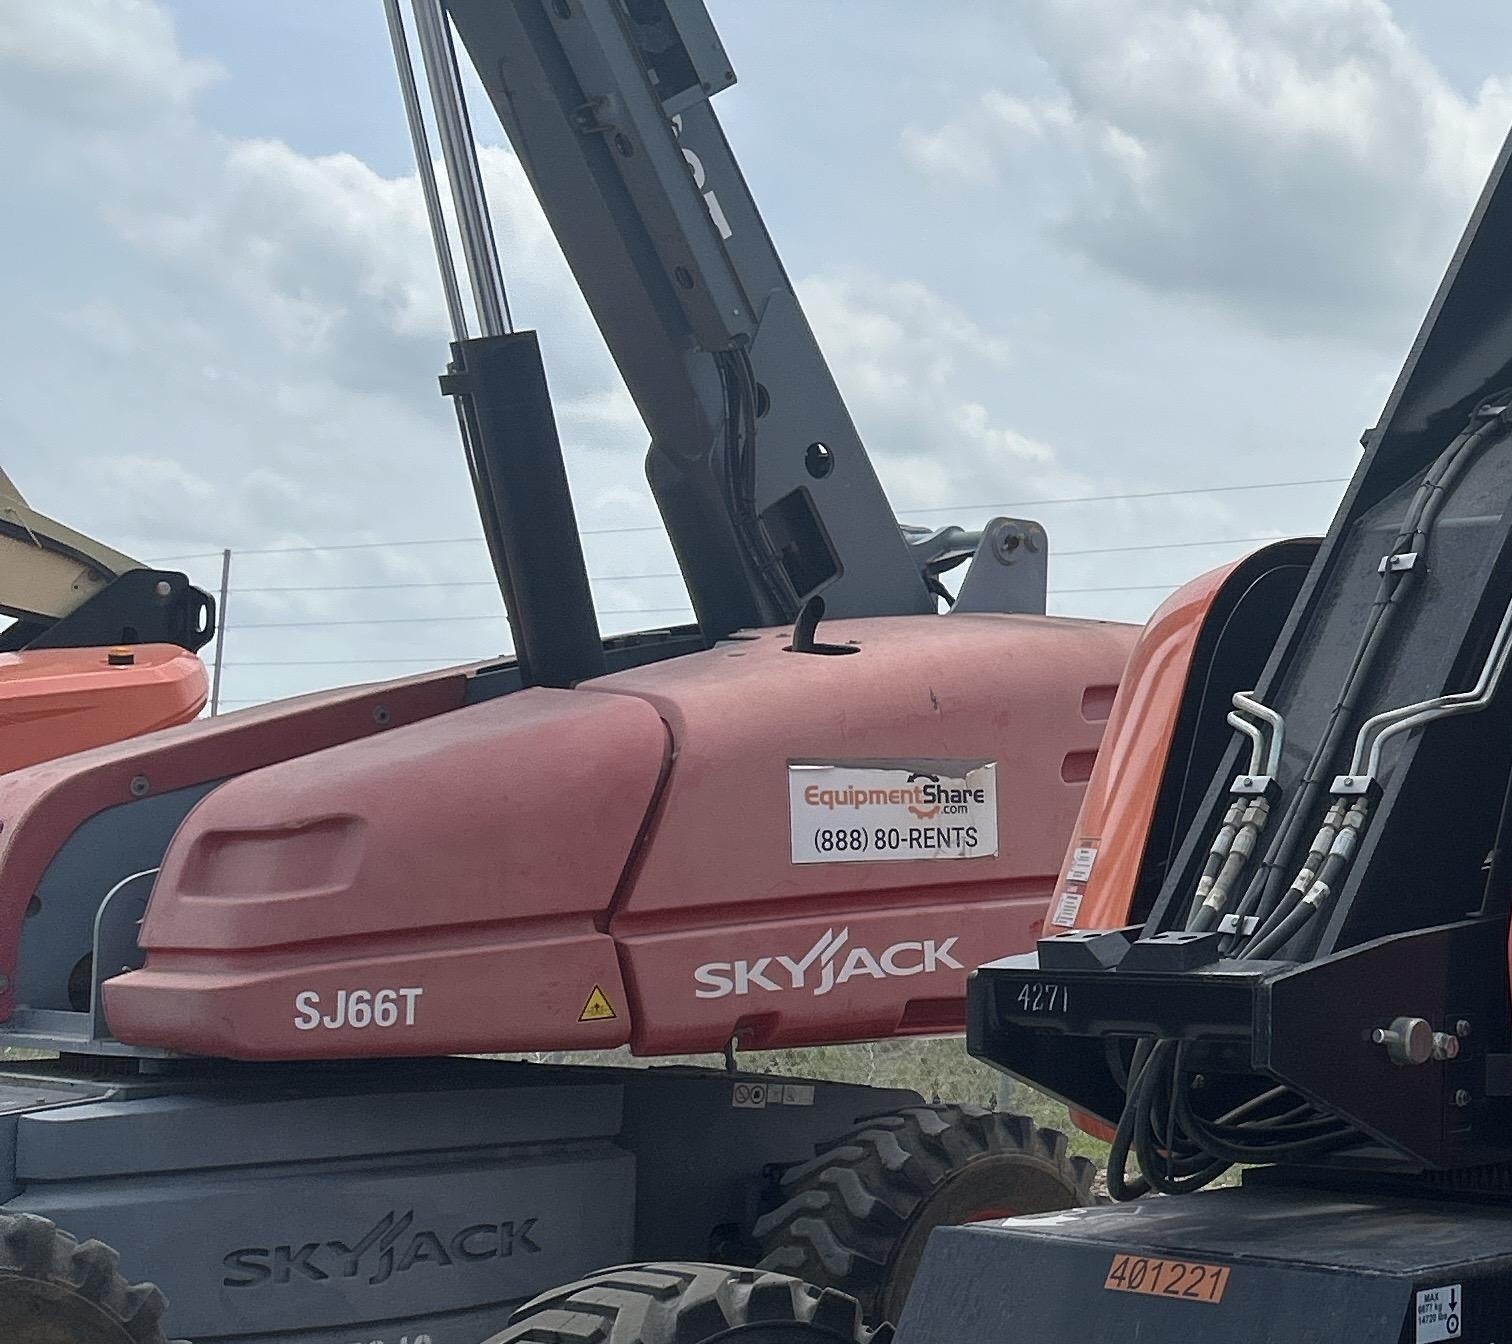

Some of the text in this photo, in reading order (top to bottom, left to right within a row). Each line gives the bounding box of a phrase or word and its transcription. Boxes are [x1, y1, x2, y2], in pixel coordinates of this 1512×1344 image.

[804, 784, 985, 811] EquipmentShare
[940, 804, 968, 815] .com
[814, 826, 979, 854] (888) 80-RENTS
[693, 925, 965, 999] SKYJACK
[293, 986, 424, 1031] SJ66T
[1017, 982, 1069, 1013] 4271
[222, 1208, 543, 1289] SKYJACK
[1109, 1256, 1223, 1300] 401221
